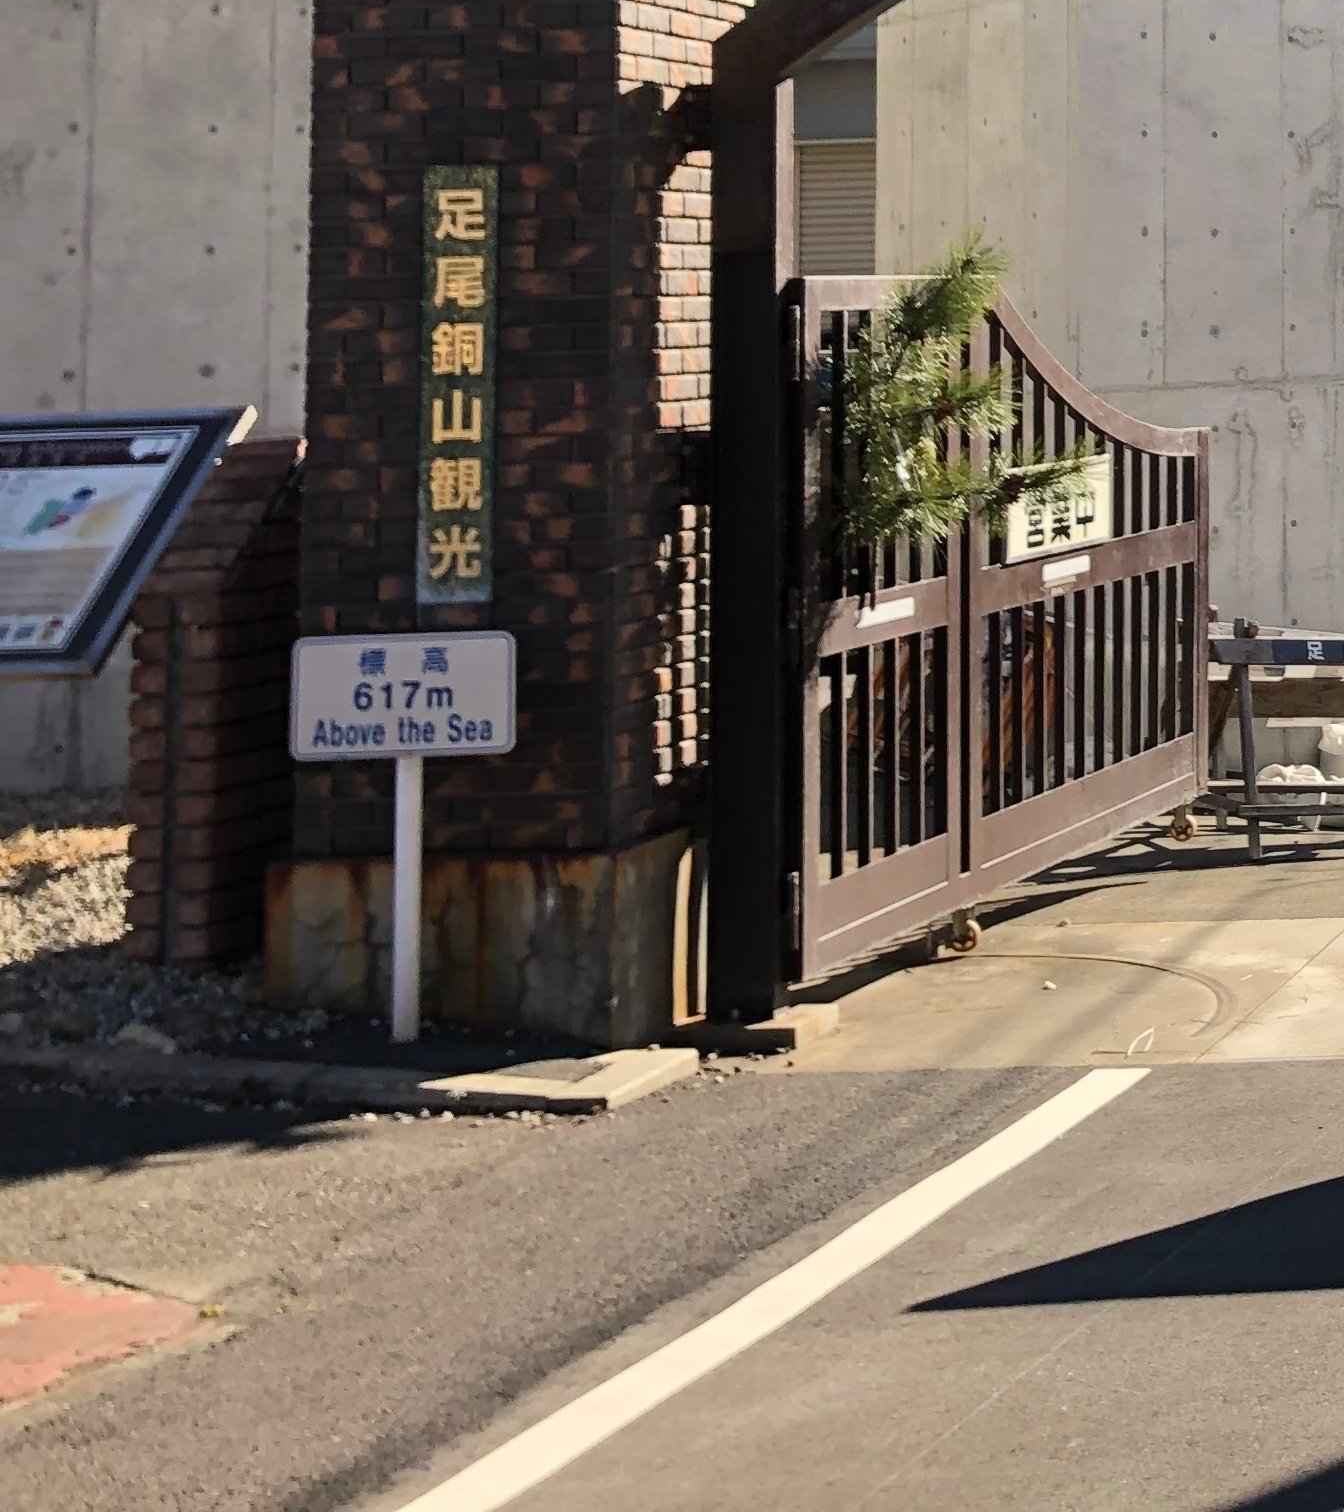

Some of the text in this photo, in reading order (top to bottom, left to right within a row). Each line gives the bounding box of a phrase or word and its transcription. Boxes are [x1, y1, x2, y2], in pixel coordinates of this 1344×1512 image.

[429, 187, 486, 579] 足尾銅山観光
[352, 680, 454, 712] 617m
[312, 714, 494, 748] Above the Sea
